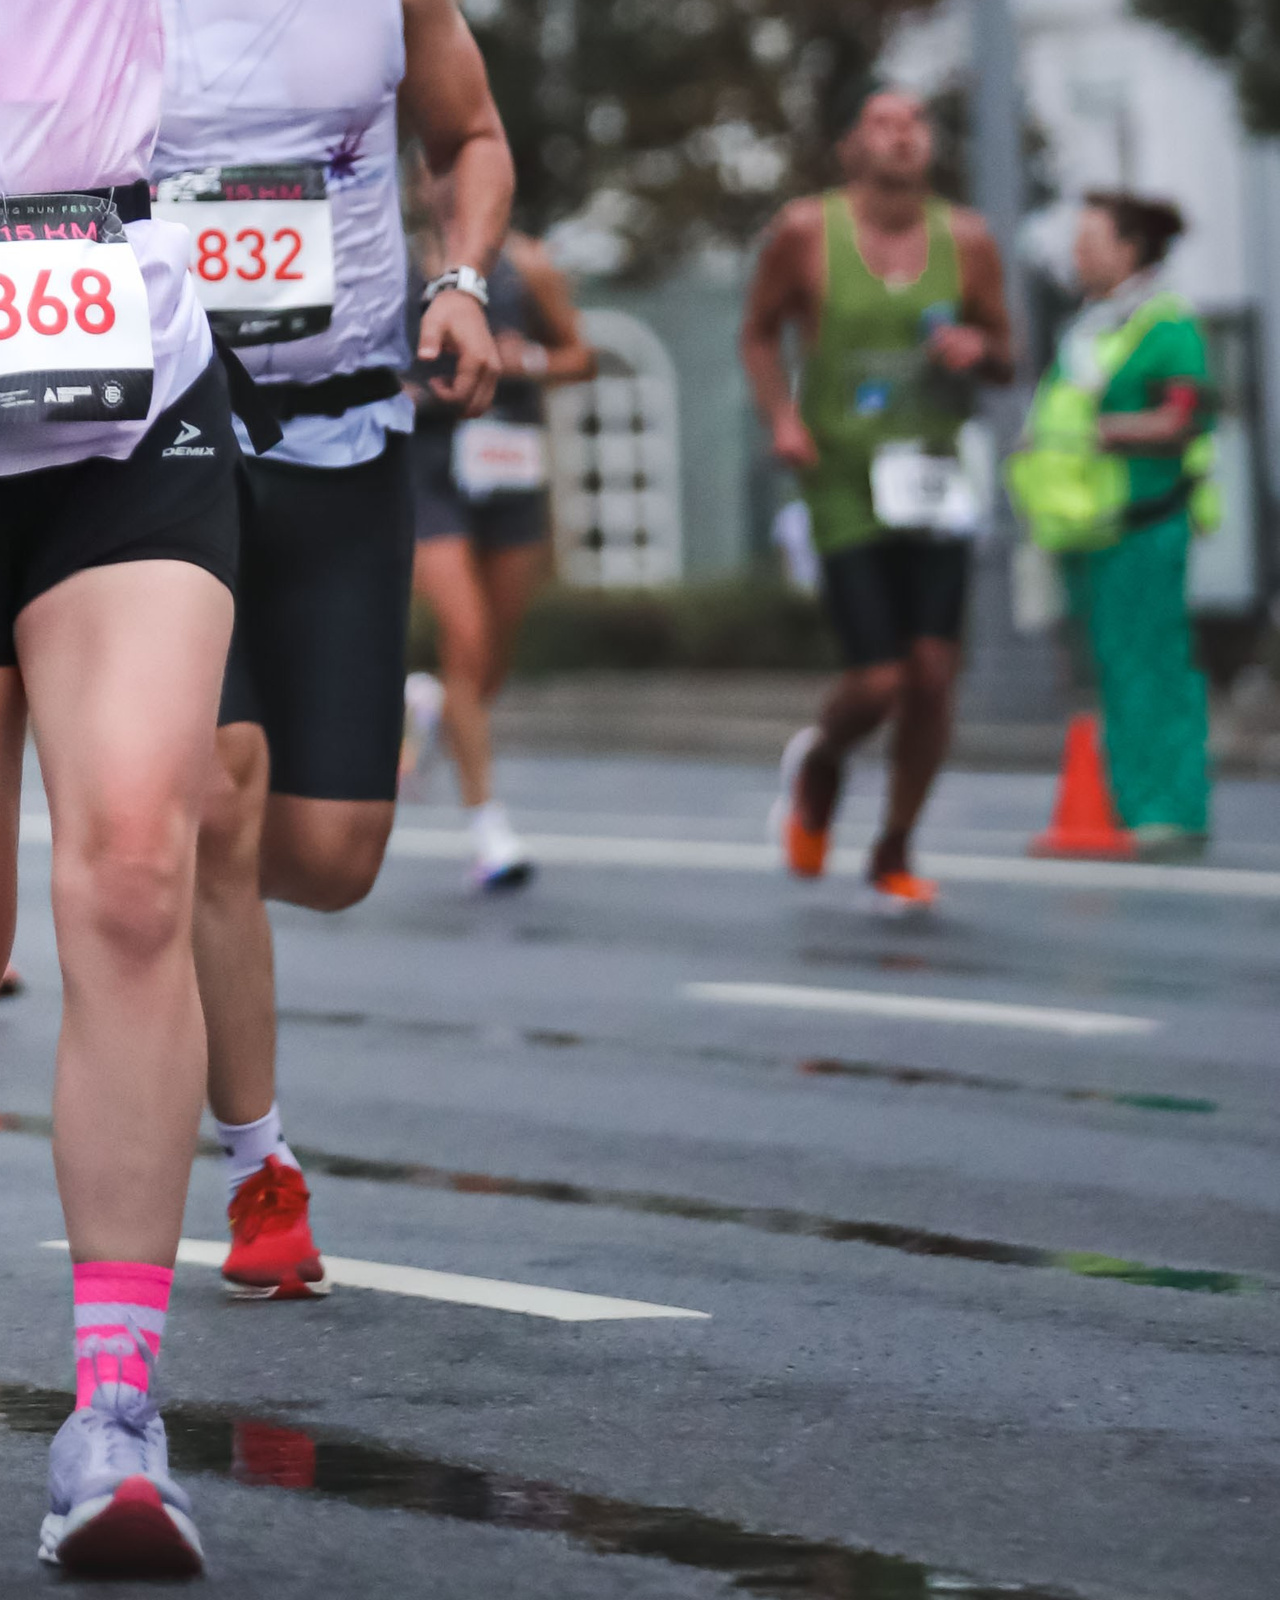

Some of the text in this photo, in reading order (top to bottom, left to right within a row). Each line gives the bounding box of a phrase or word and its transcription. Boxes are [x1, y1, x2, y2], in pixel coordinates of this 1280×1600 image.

[27, 205, 55, 214] RUN
[61, 203, 94, 213] FEST
[0, 222, 36, 241] 15
[192, 229, 304, 281] 832
[162, 447, 216, 457] DEMIX
